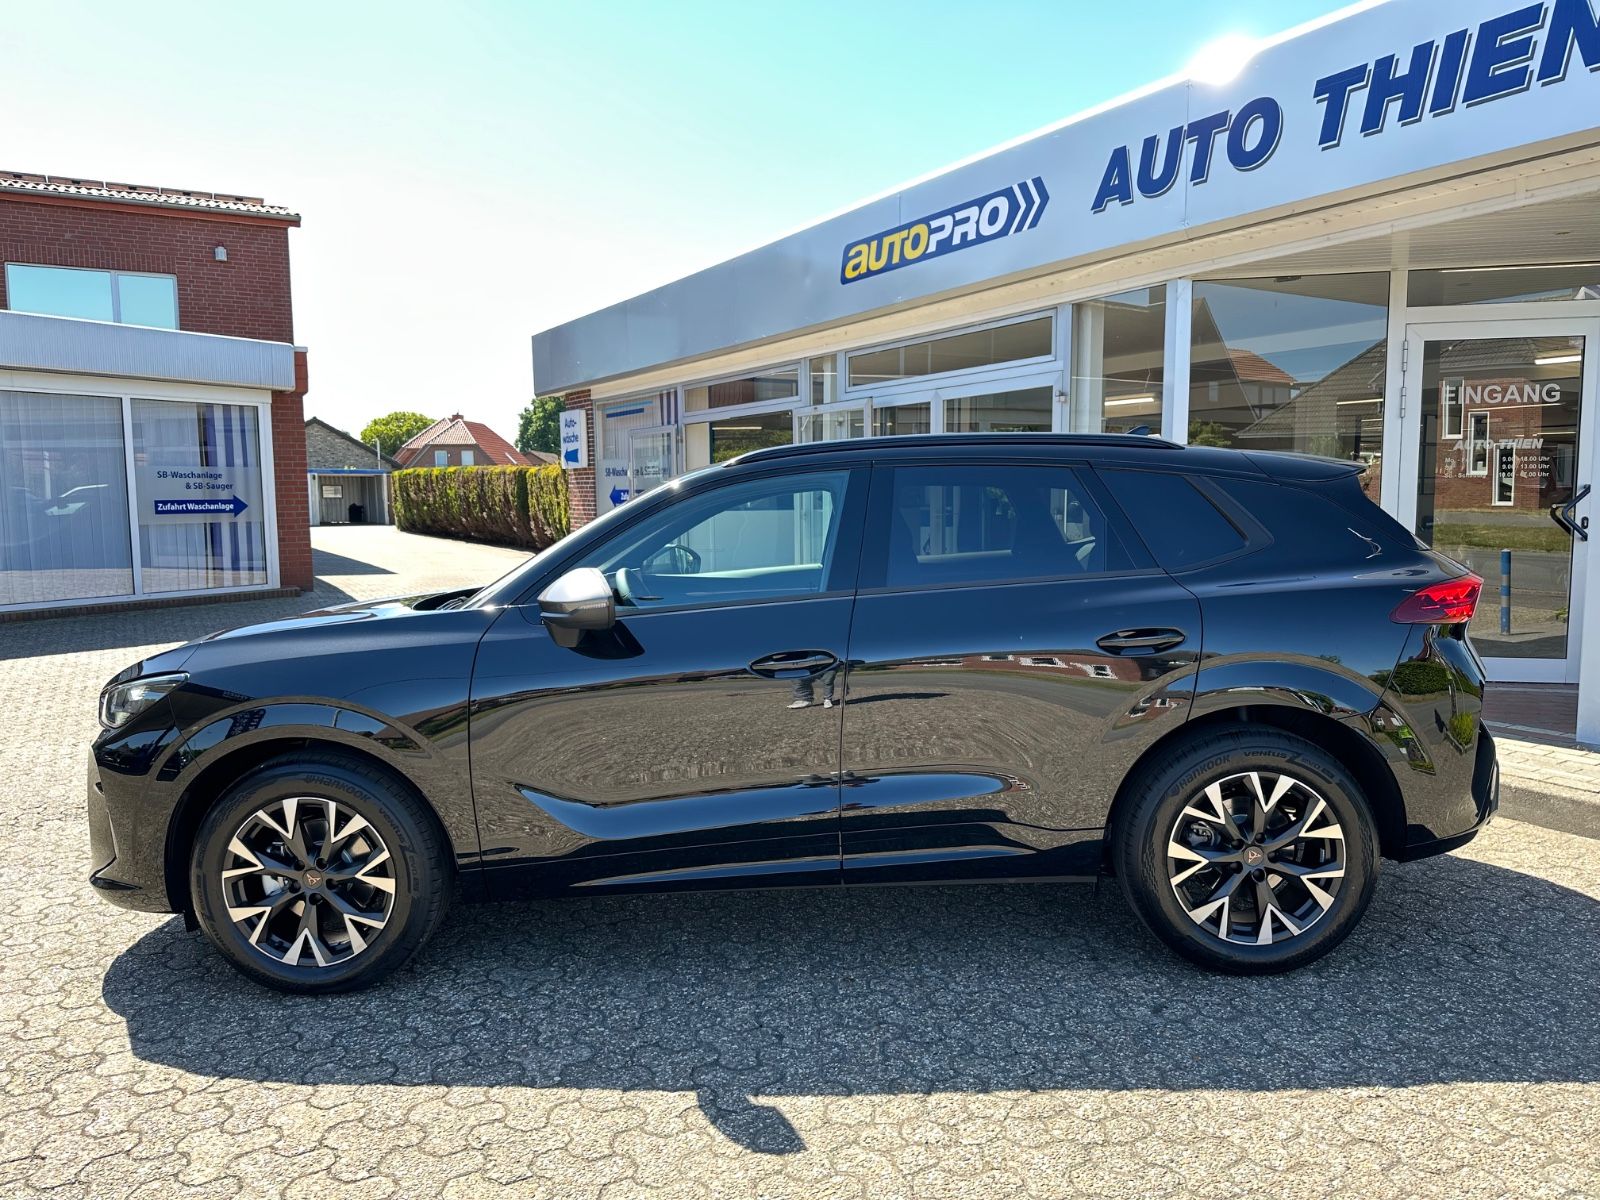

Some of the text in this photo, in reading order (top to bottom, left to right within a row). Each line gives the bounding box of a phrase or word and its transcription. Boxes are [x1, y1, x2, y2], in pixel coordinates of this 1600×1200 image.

[1091, 96, 1282, 213] AUTO
[1441, 382, 1561, 405] EINGANG
[1453, 438, 1544, 450] AUTO THIEN
[157, 470, 223, 480] SB-Waschanlage
[185, 481, 234, 491] & SB-Sauger
[157, 501, 234, 512] Zufahrt Waschanlage
